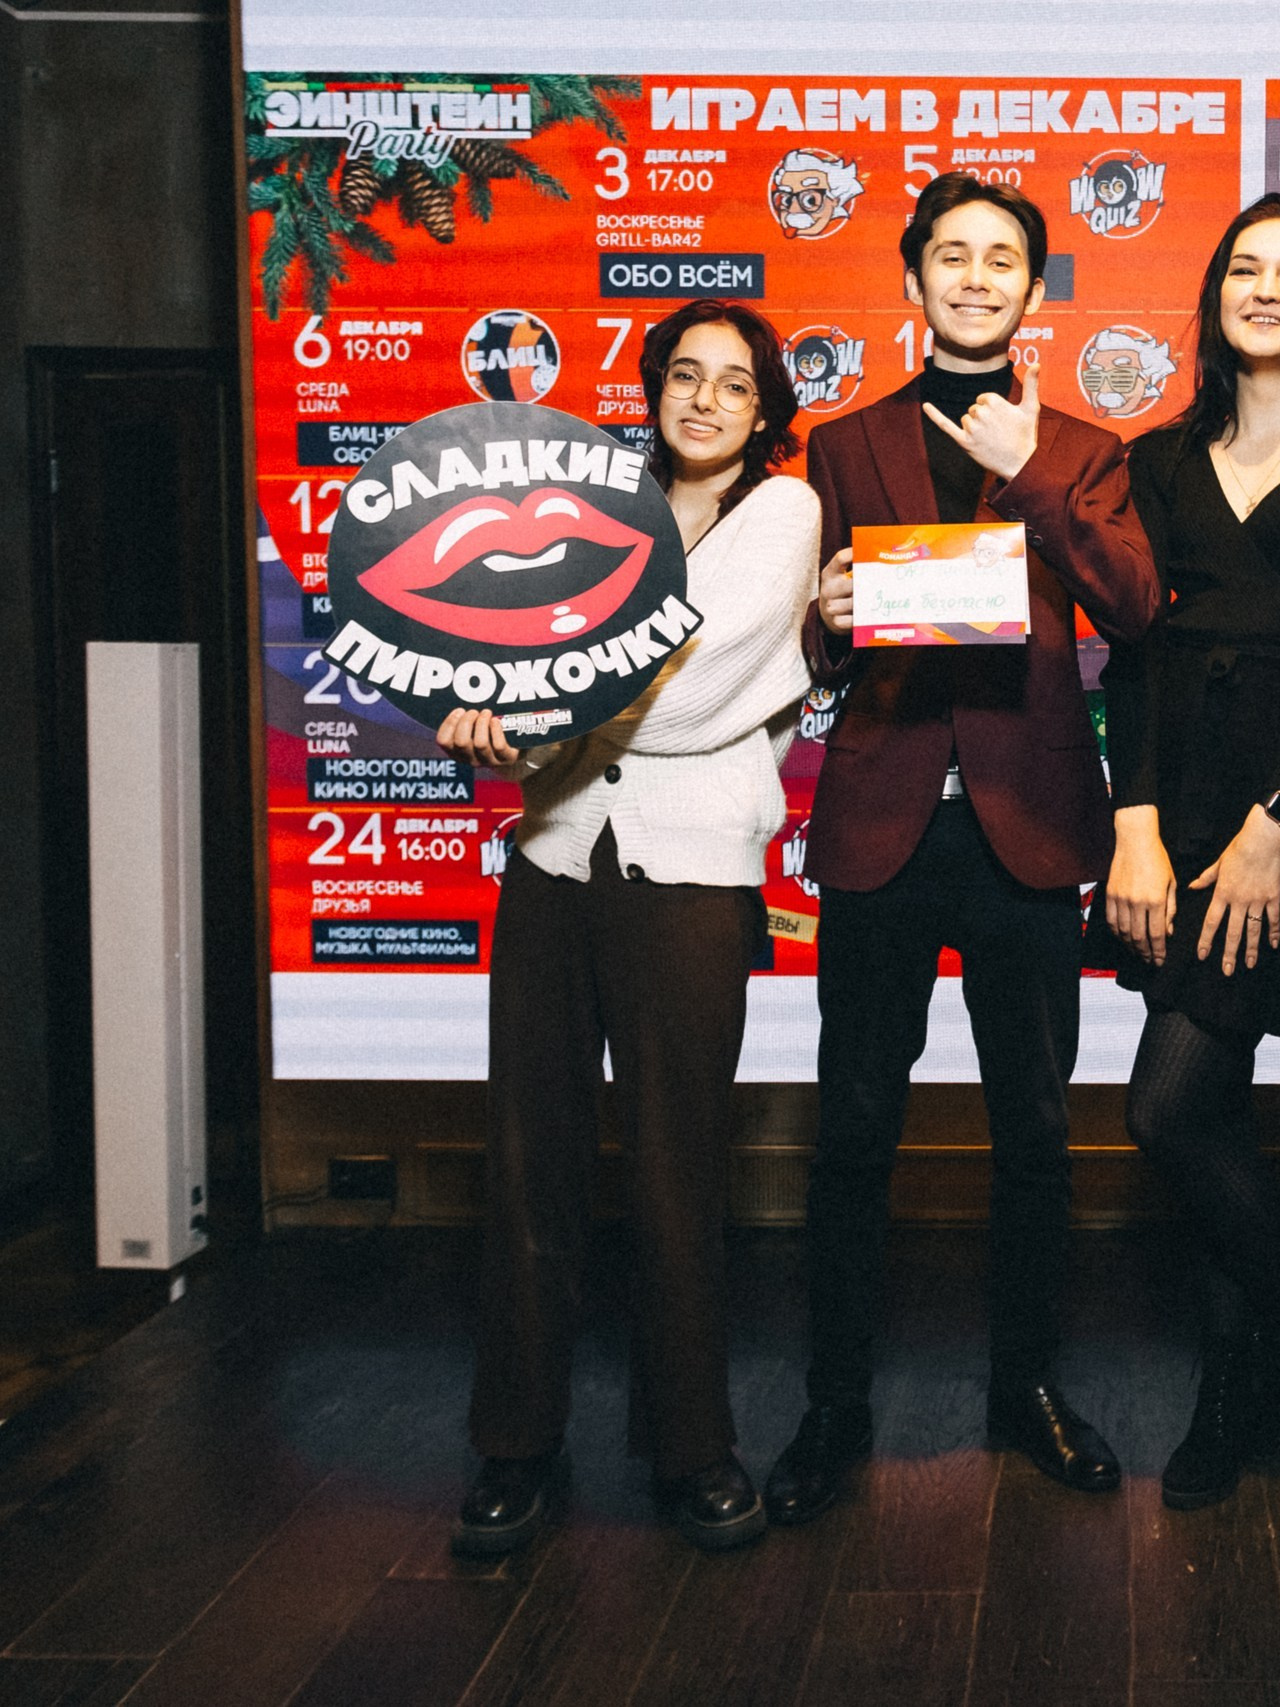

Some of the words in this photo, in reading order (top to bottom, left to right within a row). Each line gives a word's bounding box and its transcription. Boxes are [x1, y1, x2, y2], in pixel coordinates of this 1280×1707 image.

[650, 88, 886, 131] ИГРАЕМ
[901, 89, 938, 132] В
[953, 90, 1225, 138] ДЕКАБРЕ
[348, 121, 457, 168] Party
[952, 148, 1036, 164] ДЕКАБРЯ
[594, 147, 630, 200] 3
[643, 149, 728, 164] ДЕКАБРЯ
[647, 169, 714, 192] 17:00
[596, 215, 705, 229] ВОСКРЕСЕНЬЕ
[1090, 199, 1142, 235] QUIZ
[596, 233, 702, 247] GRILL-BAR42
[608, 264, 672, 287] ОБО
[679, 260, 753, 287] ВСЁМ
[294, 314, 331, 368] 6
[339, 321, 423, 335] ДЕКАБРЯ
[344, 339, 410, 362] 19:00
[597, 317, 632, 371] 7
[467, 345, 549, 373] БЛИЦ
[296, 382, 349, 397] СРЕДА
[298, 399, 341, 413] LUNA
[347, 439, 646, 524] СЛАДКИЕ
[326, 595, 700, 704] ПИРОЖОЧКИ
[305, 722, 358, 737] СРЕДА
[307, 740, 350, 754] LUNA
[325, 760, 457, 778] НОВОГОДНИЕ
[314, 782, 368, 799] КИНО
[373, 783, 387, 799] И
[390, 783, 469, 799] МУЗЫКА
[308, 812, 386, 865] 24
[394, 819, 478, 834] ДЕКАБРЯ
[397, 838, 466, 861] 16:00
[312, 880, 424, 895] ВОСКРЕСЕНЬЕ
[311, 899, 371, 914] ДРУЗЬЯ
[328, 927, 419, 941] НОВОГОДНИЕ
